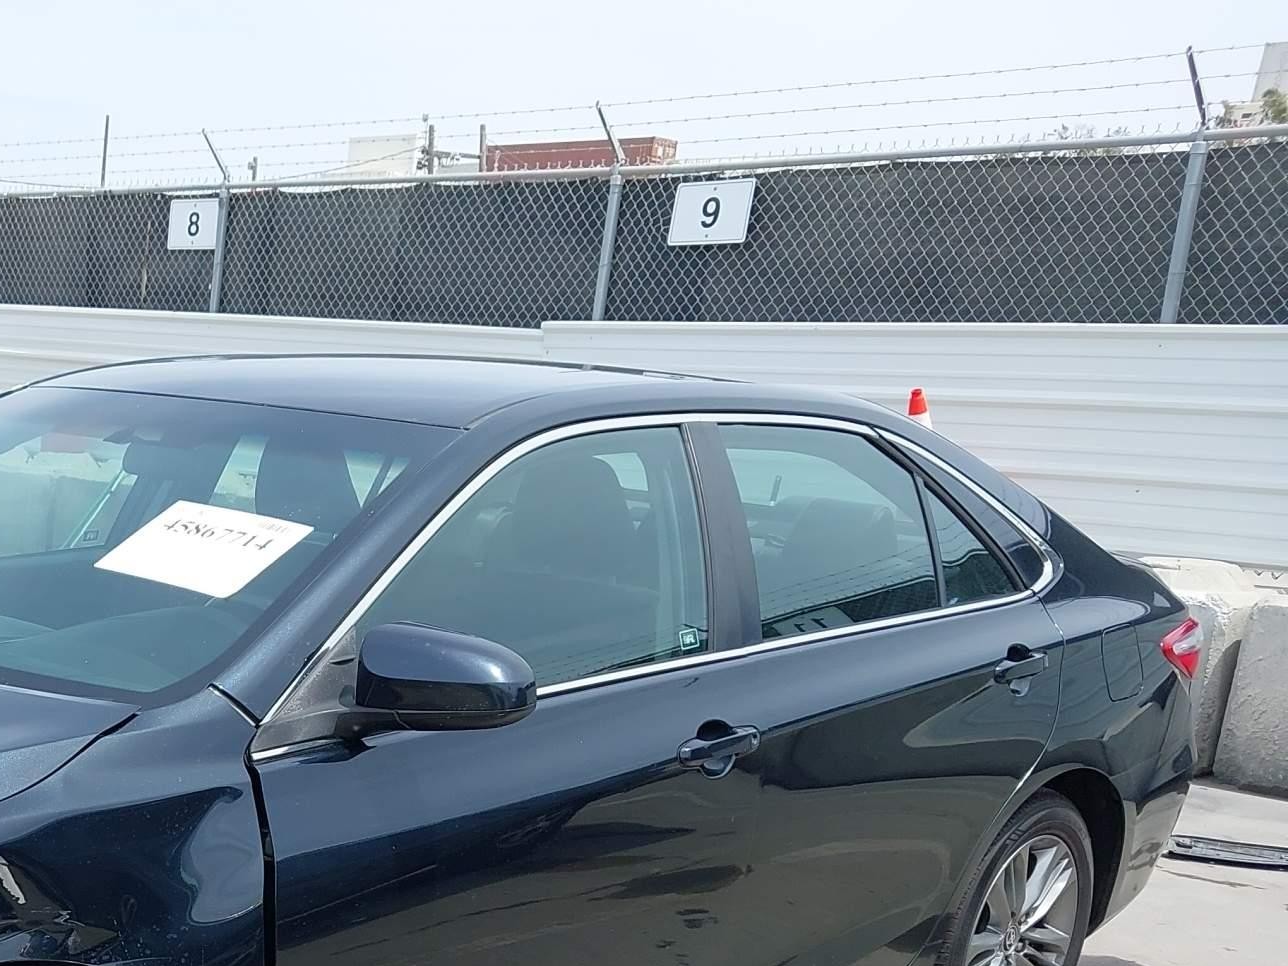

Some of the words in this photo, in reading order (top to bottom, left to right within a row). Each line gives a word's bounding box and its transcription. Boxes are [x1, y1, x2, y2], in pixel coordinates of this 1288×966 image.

[188, 212, 200, 236] 8
[701, 196, 721, 229] 9
[164, 519, 274, 550] 45867714
